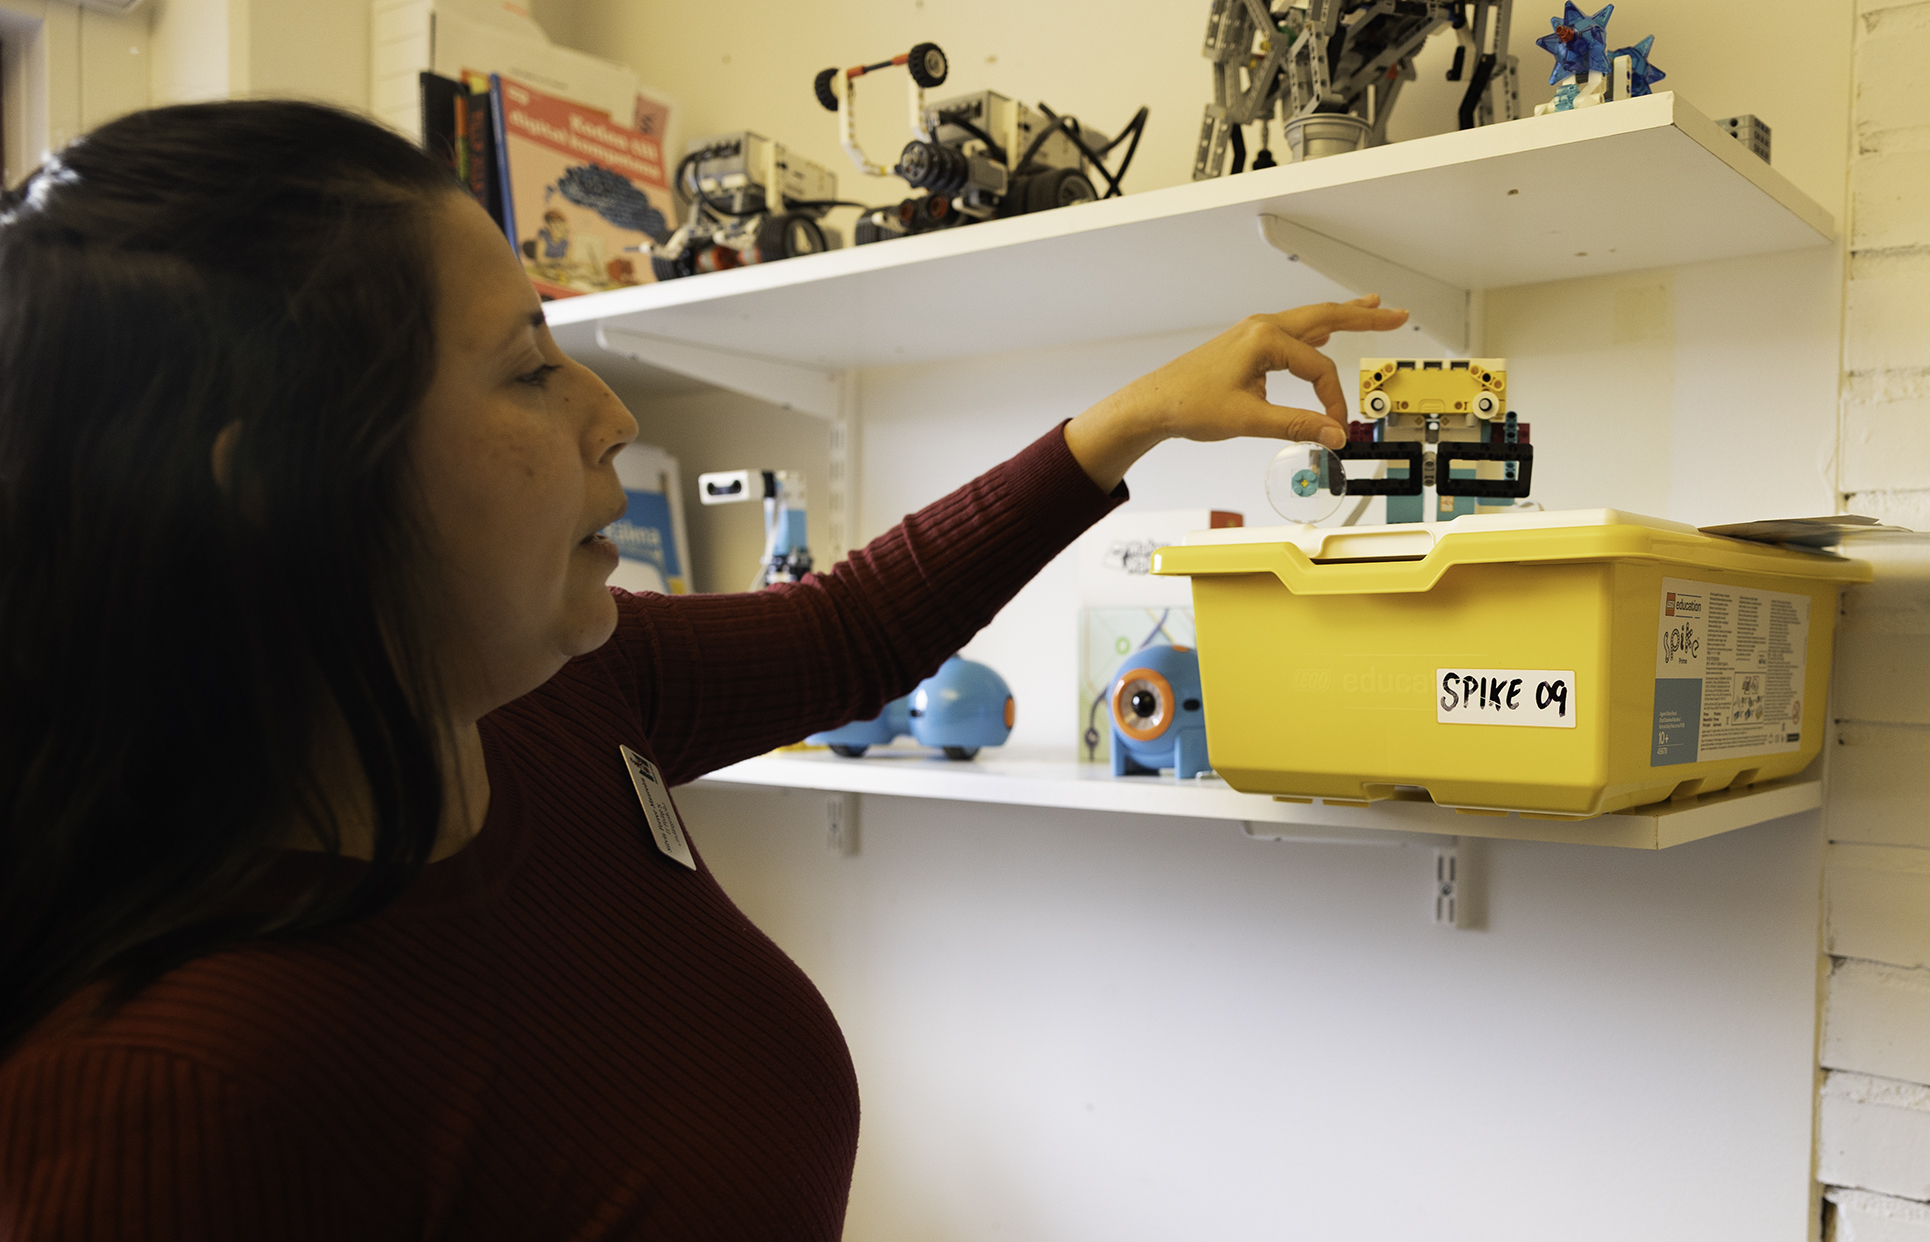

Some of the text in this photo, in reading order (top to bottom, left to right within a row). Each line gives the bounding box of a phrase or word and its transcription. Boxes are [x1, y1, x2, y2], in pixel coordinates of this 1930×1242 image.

[1676, 599, 1701, 612] education
[1663, 621, 1699, 664] spike
[1292, 668, 1331, 692] LEGO
[1440, 671, 1568, 718] SPIKE 09
[1658, 731, 1669, 745] 10+
